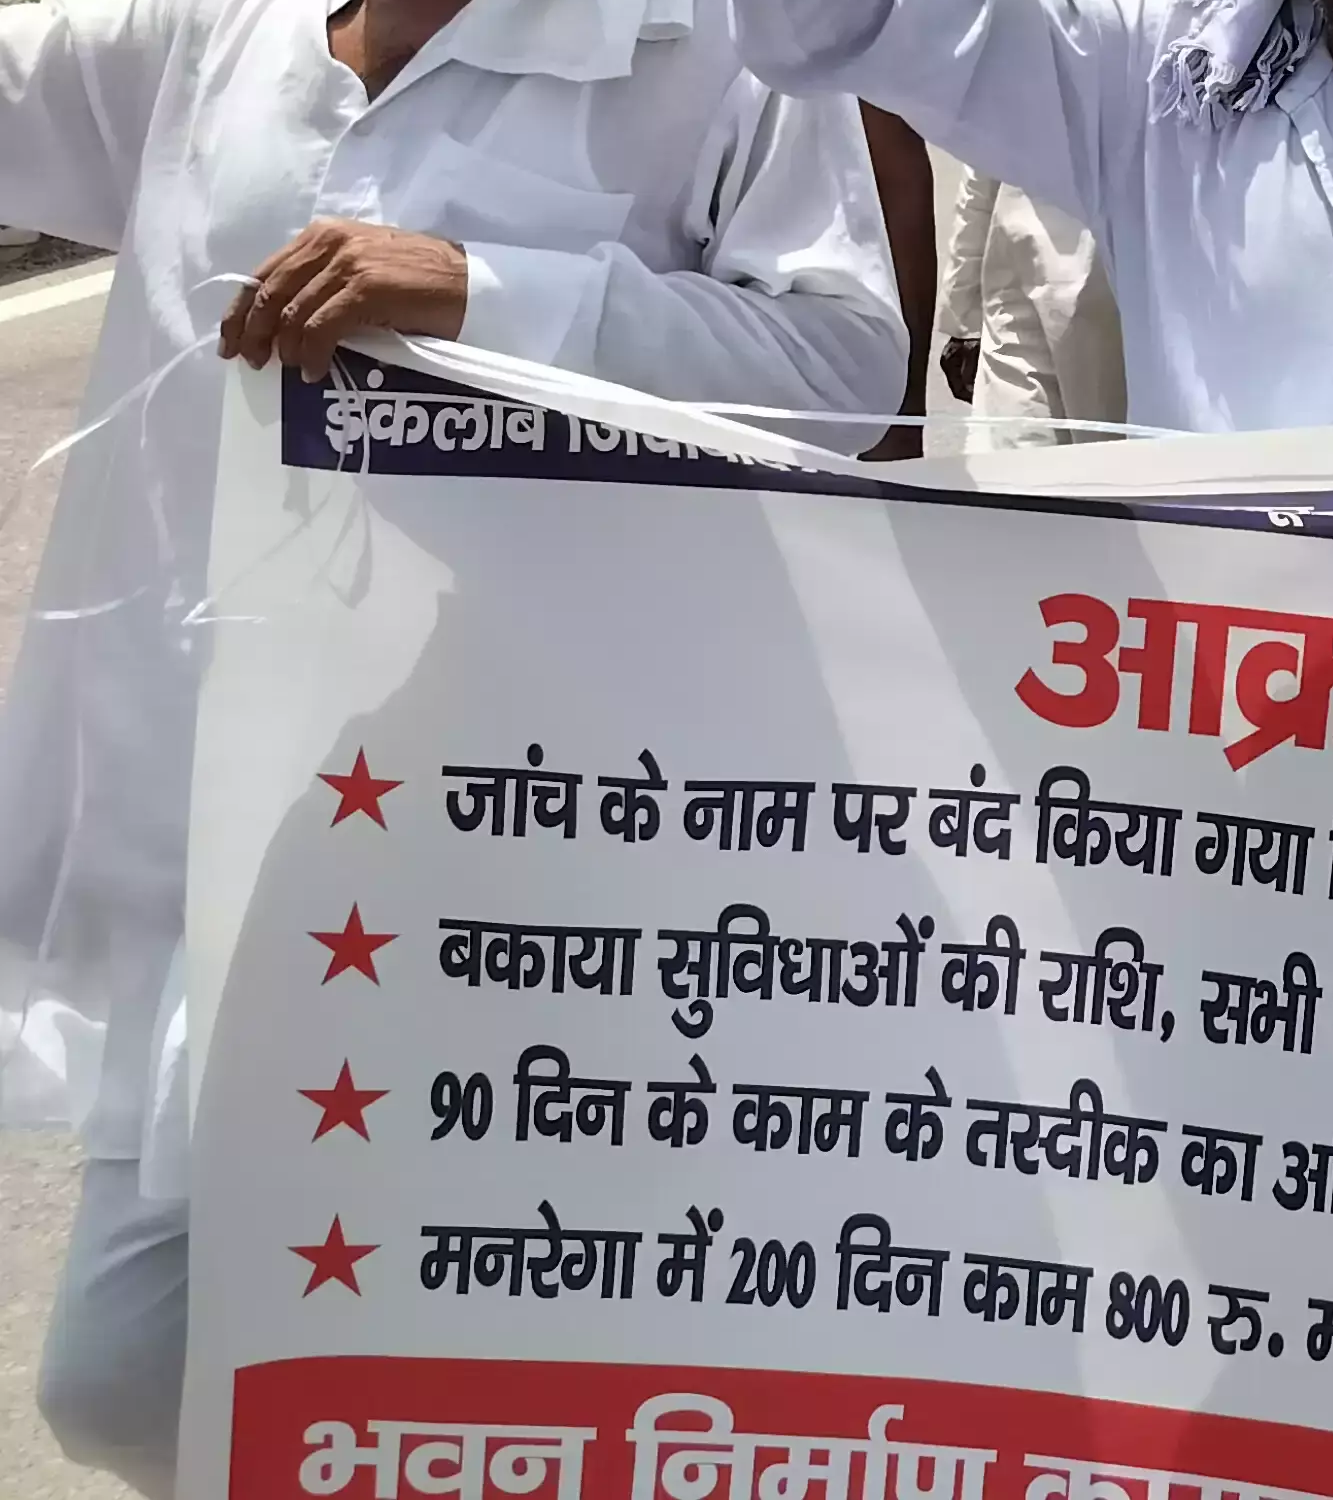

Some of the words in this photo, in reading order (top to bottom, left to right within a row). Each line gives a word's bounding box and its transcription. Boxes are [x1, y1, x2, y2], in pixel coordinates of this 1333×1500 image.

[441, 742, 583, 841] जांच
[597, 748, 667, 845] के
[684, 778, 814, 853] नाम
[831, 780, 917, 857] पर
[928, 763, 1021, 862] बंद
[1034, 765, 1182, 877] किया
[1195, 812, 1314, 896] गया
[439, 917, 641, 997] बकाया
[657, 903, 935, 1039] सुविधाओं
[940, 914, 1026, 1016] की
[1039, 927, 1176, 1044] राशि,
[1200, 951, 1322, 1056] सभी
[514, 1045, 631, 1148] दिन
[647, 1054, 717, 1149] के
[732, 1083, 868, 1159] काम
[885, 1066, 952, 1162] के
[966, 1078, 1167, 1187] तस्दीक
[1180, 1126, 1262, 1203] का
[420, 1200, 642, 1300] मनरेगा
[656, 1205, 725, 1303] में
[726, 1237, 816, 1310] 200
[836, 1213, 950, 1318] दिन
[962, 1252, 1094, 1334] काम
[1105, 1272, 1190, 1348] 800
[1207, 1284, 1284, 1360] रु.
[299, 1418, 597, 1500] भवन
